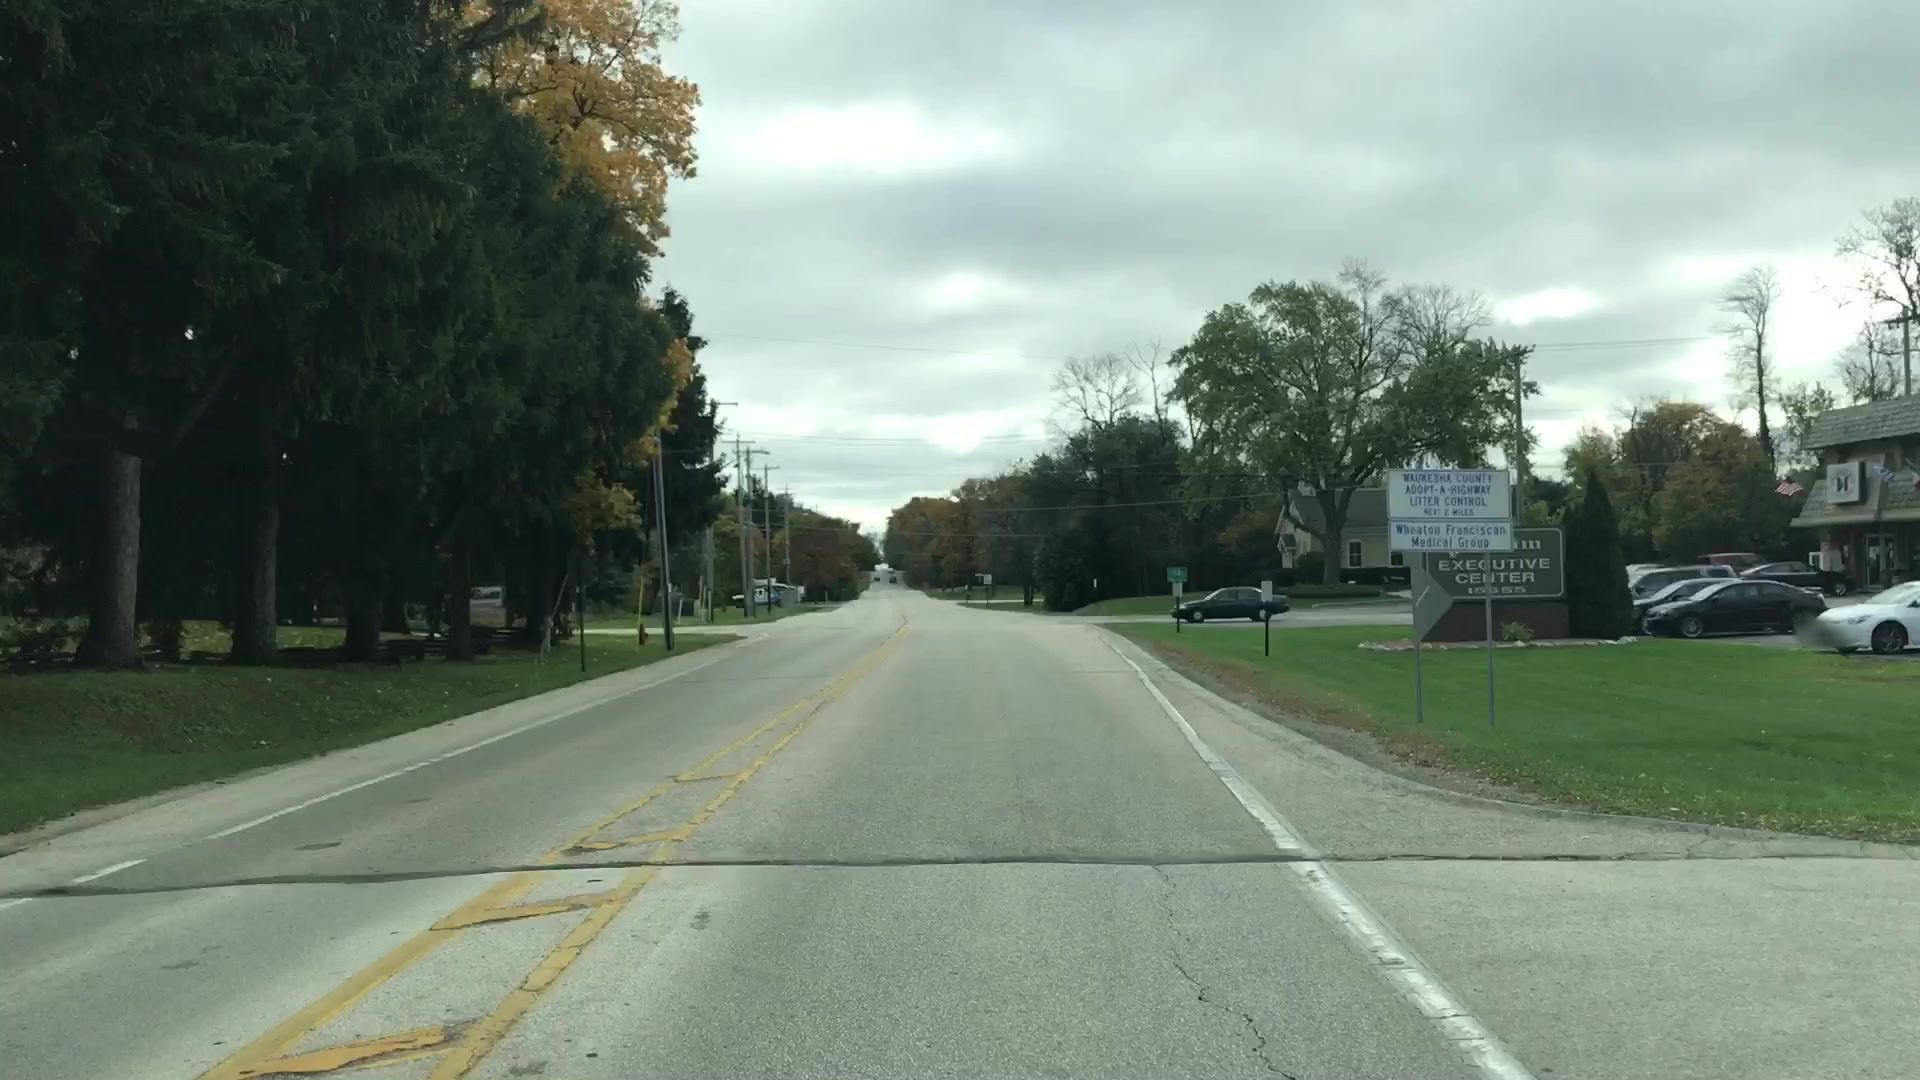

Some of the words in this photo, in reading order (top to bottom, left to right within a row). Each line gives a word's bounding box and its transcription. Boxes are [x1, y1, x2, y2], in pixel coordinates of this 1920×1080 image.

[1403, 473, 1452, 483] WAUKESHA
[1456, 473, 1492, 483] COUNTY
[1405, 485, 1491, 495] ADOPT-A-HIGHWAY
[1409, 496, 1440, 507] LITTER
[1444, 496, 1487, 507] CONTROL
[1423, 508, 1441, 516] NEXT
[1452, 508, 1474, 516] MILES
[1396, 524, 1440, 536] Wheaton
[1446, 524, 1506, 536] Franciscan
[1411, 536, 1453, 548] Medical
[1458, 537, 1490, 548] Group
[1438, 558, 1551, 571] EXECUTIVE
[1455, 572, 1535, 584] CENTER
